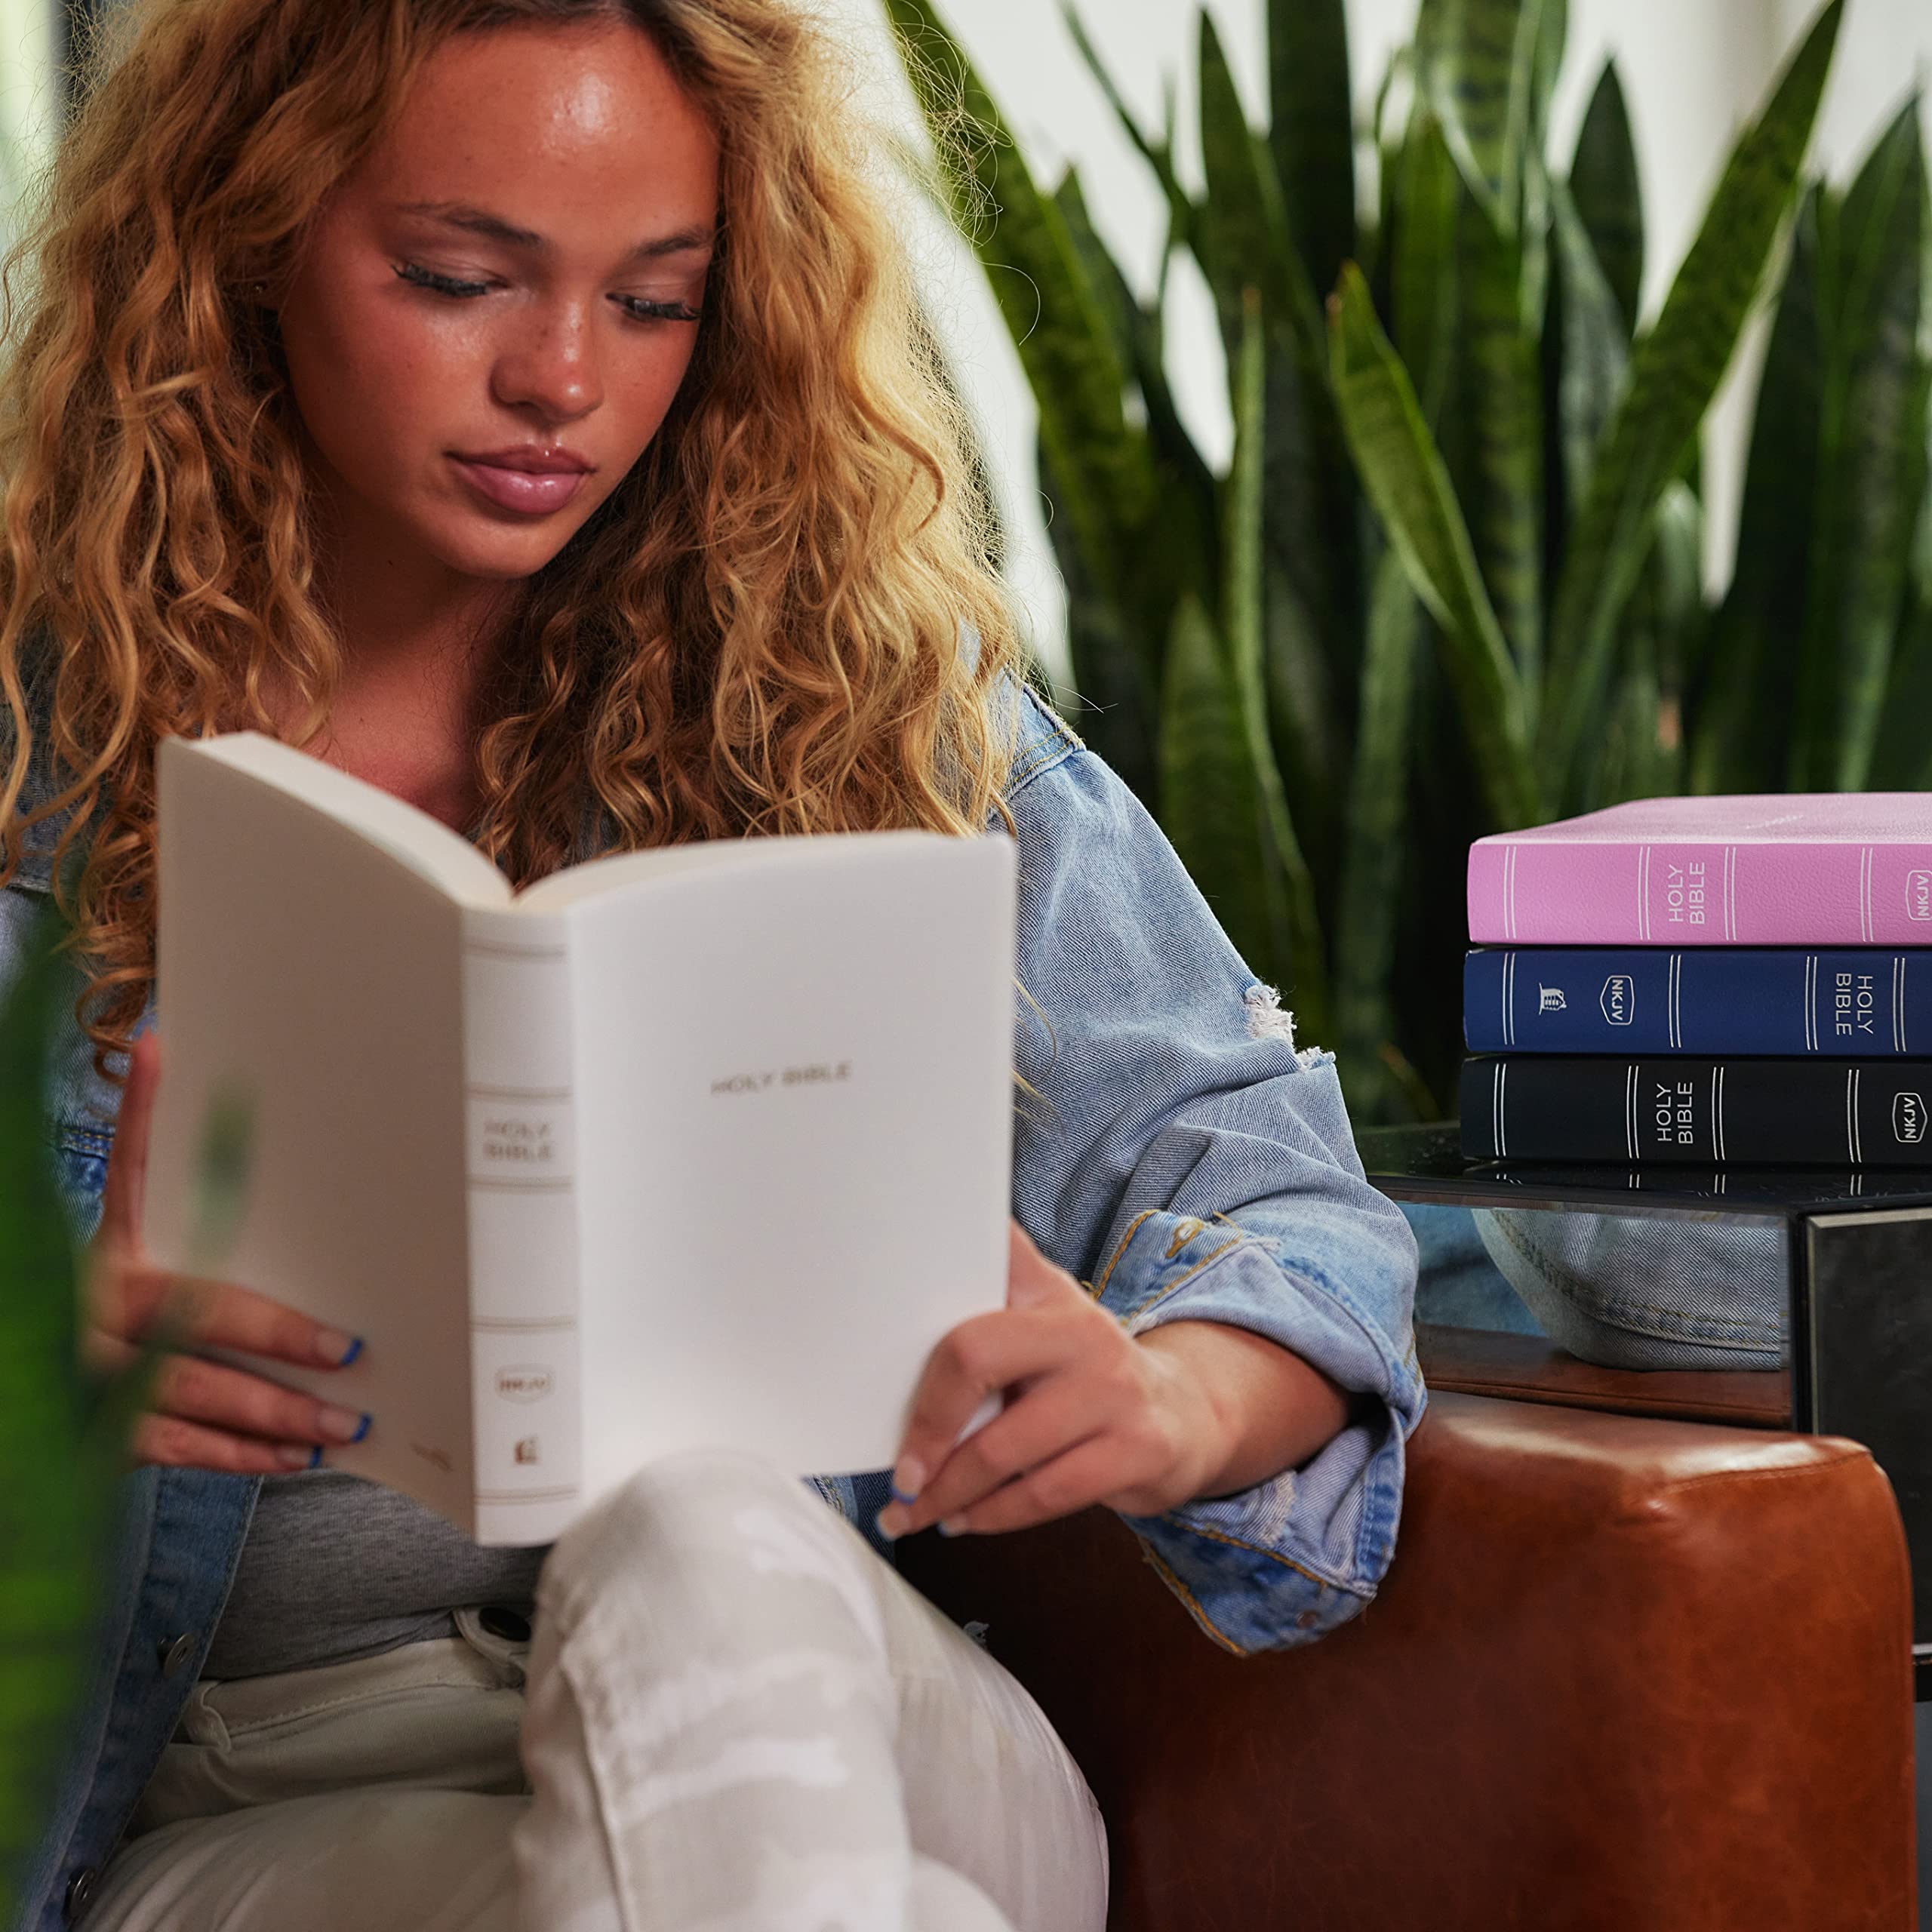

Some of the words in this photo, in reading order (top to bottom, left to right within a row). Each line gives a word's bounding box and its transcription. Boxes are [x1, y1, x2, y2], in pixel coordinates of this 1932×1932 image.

[1668, 864, 1684, 922] HOLY
[1690, 862, 1705, 924] BIBLE
[1917, 875, 1930, 917] NKJV
[1612, 980, 1623, 1021] NKJV
[1835, 973, 1852, 1035] BIBLE
[1857, 976, 1874, 1034] HOLY
[1656, 1083, 1672, 1142] HOLY
[1678, 1081, 1694, 1144] BIBLE
[1904, 1097, 1917, 1139] NKJV
